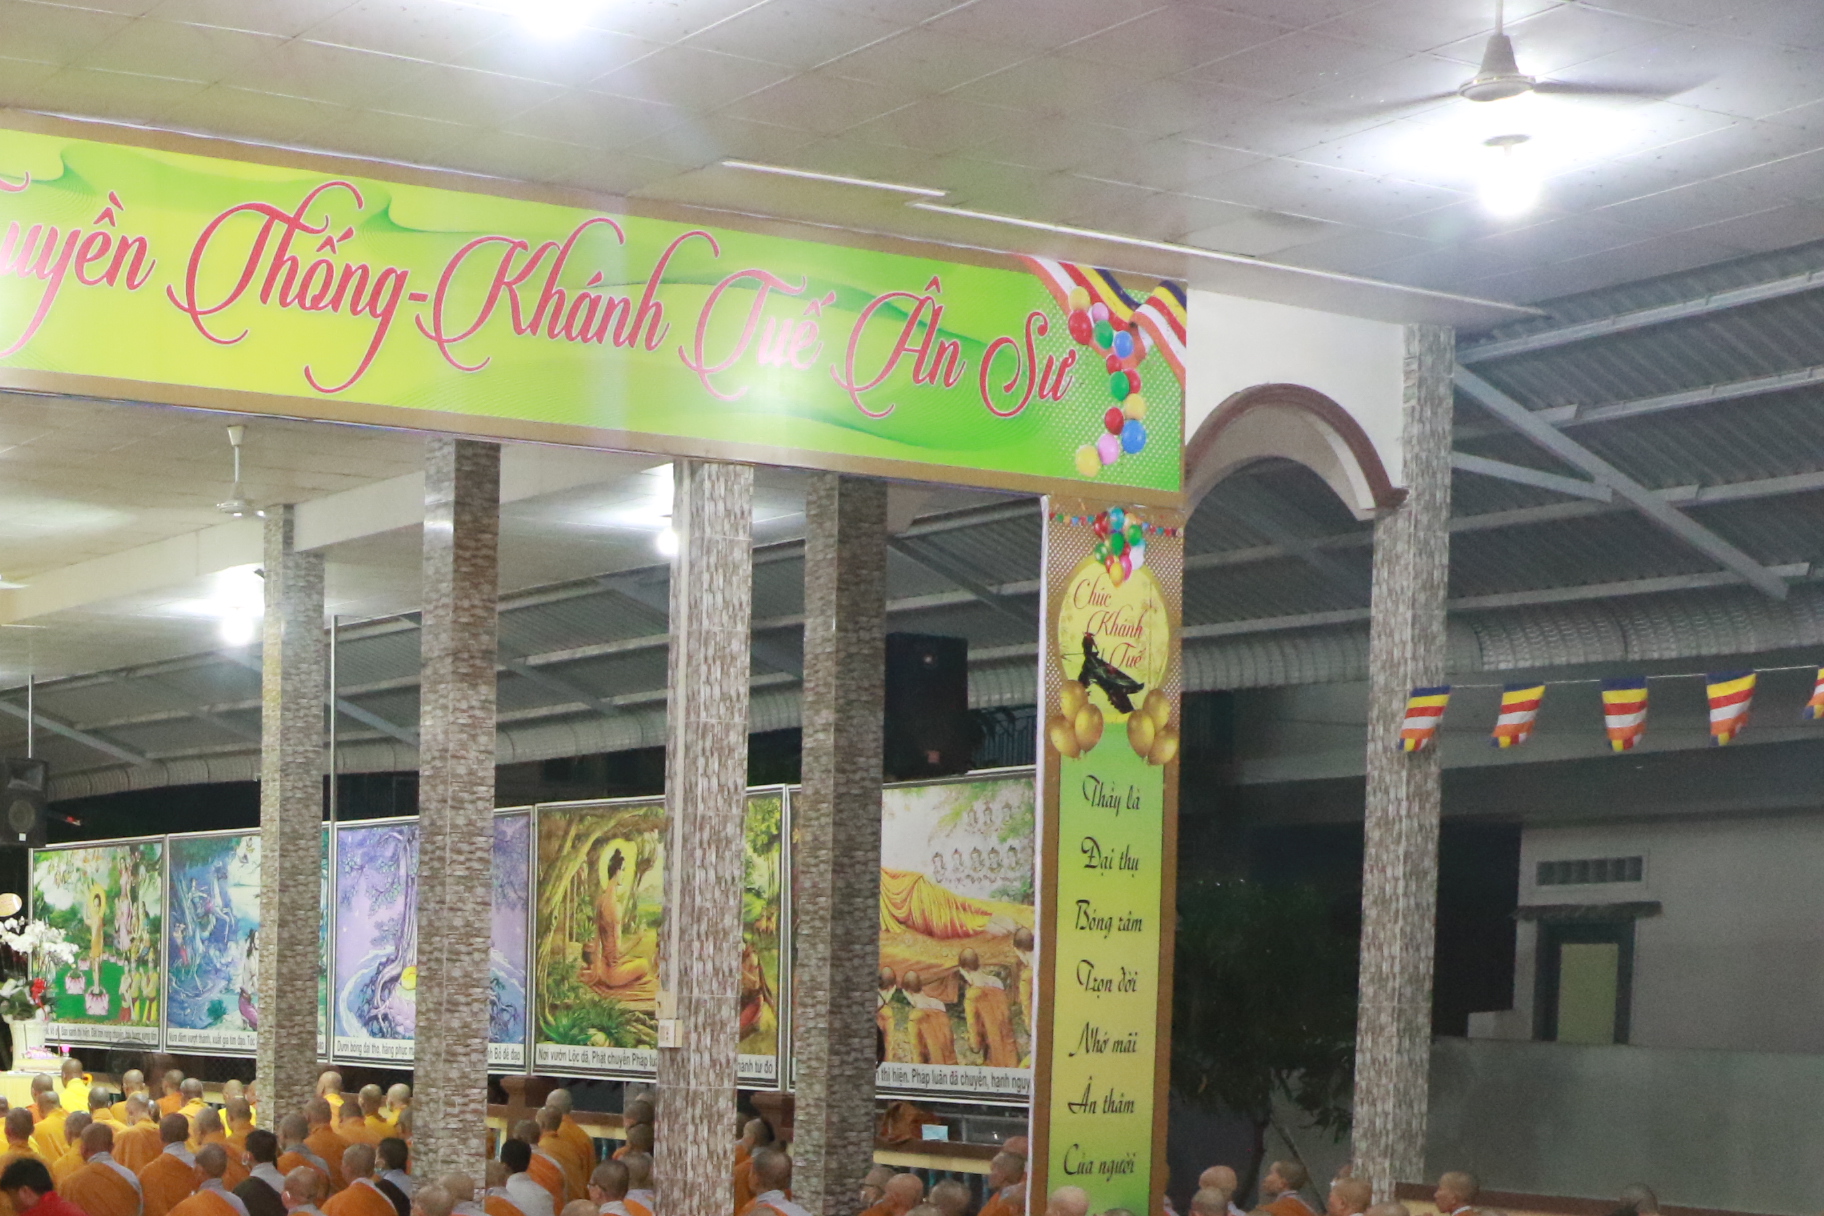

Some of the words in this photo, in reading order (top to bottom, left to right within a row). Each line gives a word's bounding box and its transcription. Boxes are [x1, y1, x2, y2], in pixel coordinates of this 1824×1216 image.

[677, 267, 837, 402] Tuế
[829, 276, 967, 420] Ân
[978, 310, 1078, 420] Sư
[1073, 572, 1112, 609] Chúc
[1086, 604, 1144, 640] Khánh
[1082, 774, 1121, 817] Thầy
[1126, 784, 1141, 810] là
[1081, 836, 1114, 877] Đại
[1118, 844, 1140, 878] thụ
[1075, 899, 1114, 940] Bóng
[1076, 959, 1113, 1000] Trọn
[1117, 966, 1138, 993] đời
[1068, 1021, 1109, 1058] Nhớ
[1112, 1031, 1138, 1053] mãi
[1067, 1075, 1096, 1115] Ân
[1064, 1143, 1094, 1176] Của
[1098, 1153, 1136, 1183] người
